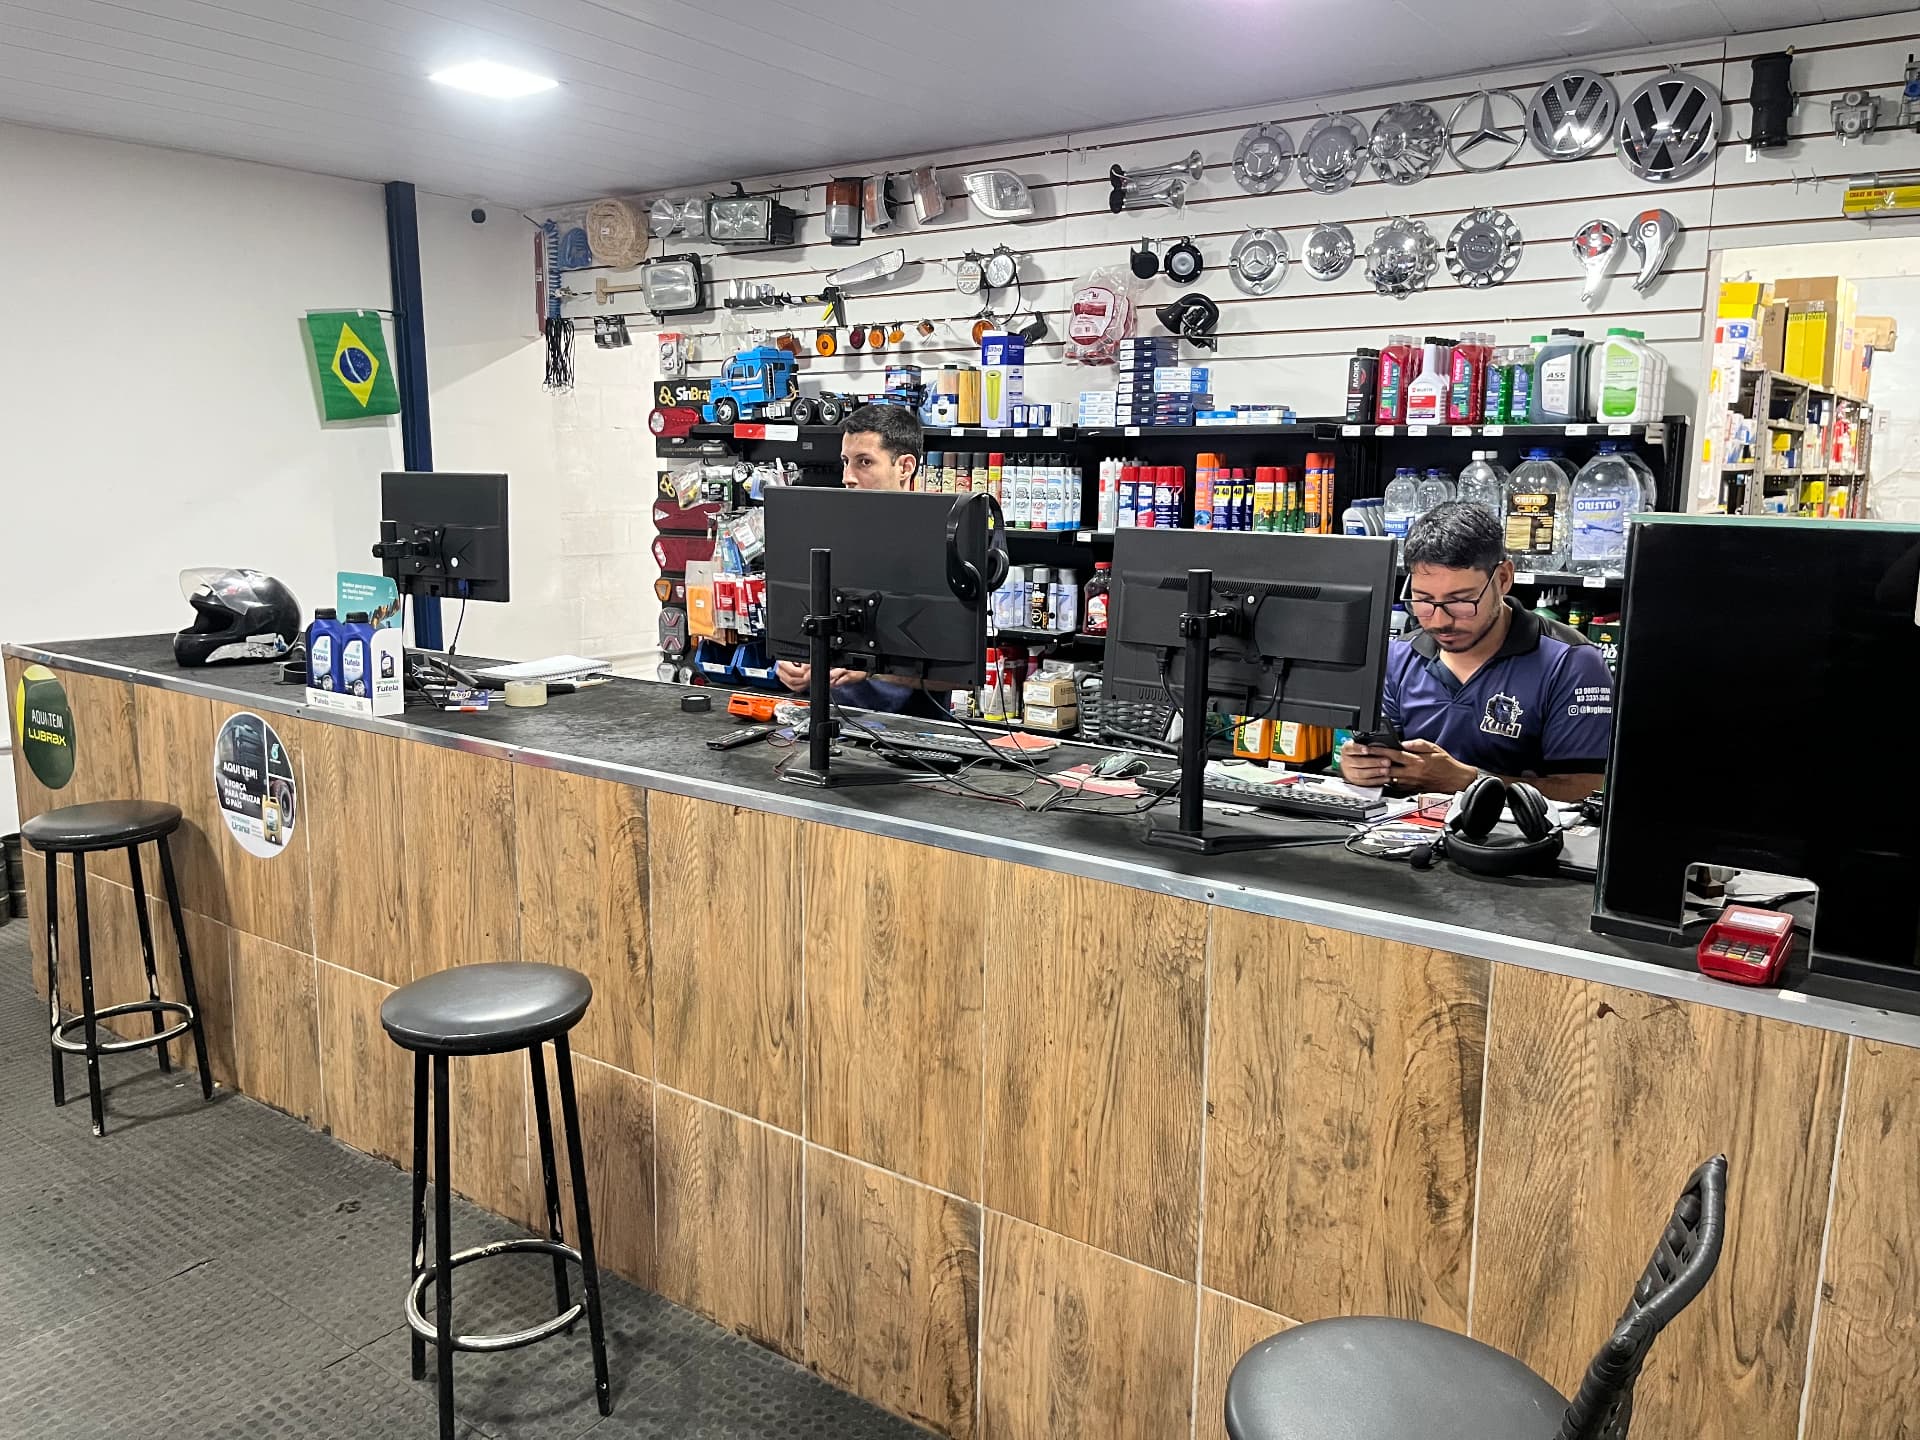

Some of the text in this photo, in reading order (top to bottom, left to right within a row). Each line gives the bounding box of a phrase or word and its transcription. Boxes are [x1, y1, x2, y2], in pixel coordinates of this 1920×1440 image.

[344, 658, 361, 667] Tutela
[31, 709, 64, 729] AQUI TEM
[223, 761, 258, 780] AQUI TEM!
[230, 779, 247, 792] FORÇA
[224, 788, 260, 805] PARA CRUZAR
